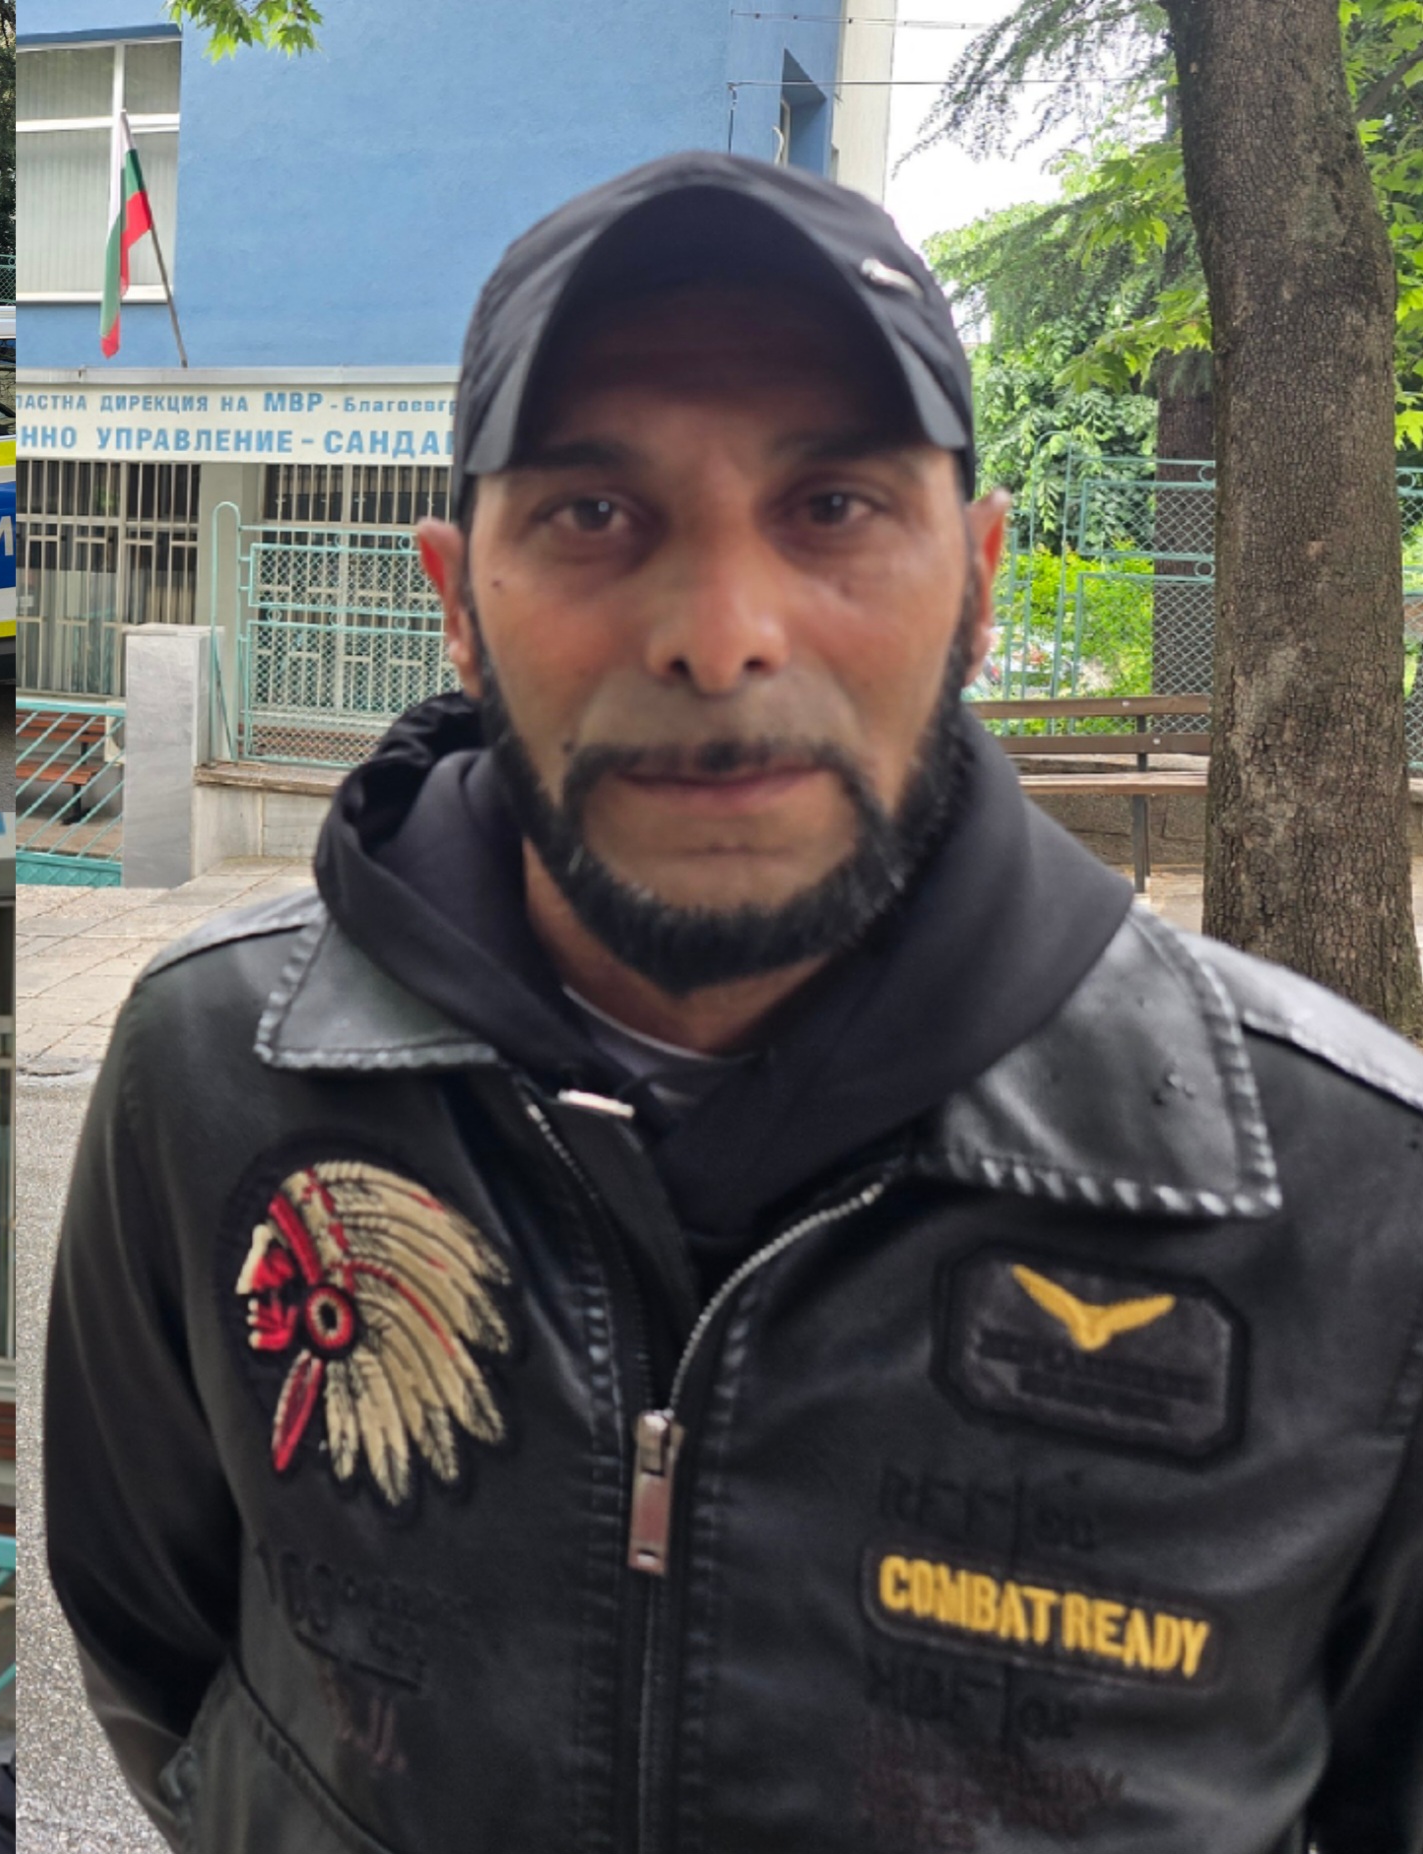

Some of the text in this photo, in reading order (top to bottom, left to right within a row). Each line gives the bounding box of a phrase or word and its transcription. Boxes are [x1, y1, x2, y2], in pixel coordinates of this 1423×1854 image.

[100, 395, 208, 413] ДИРЕКЦИЯ
[220, 396, 249, 411] НА
[16, 426, 77, 448] ННО
[879, 1555, 1211, 1679] COMBAT READY
